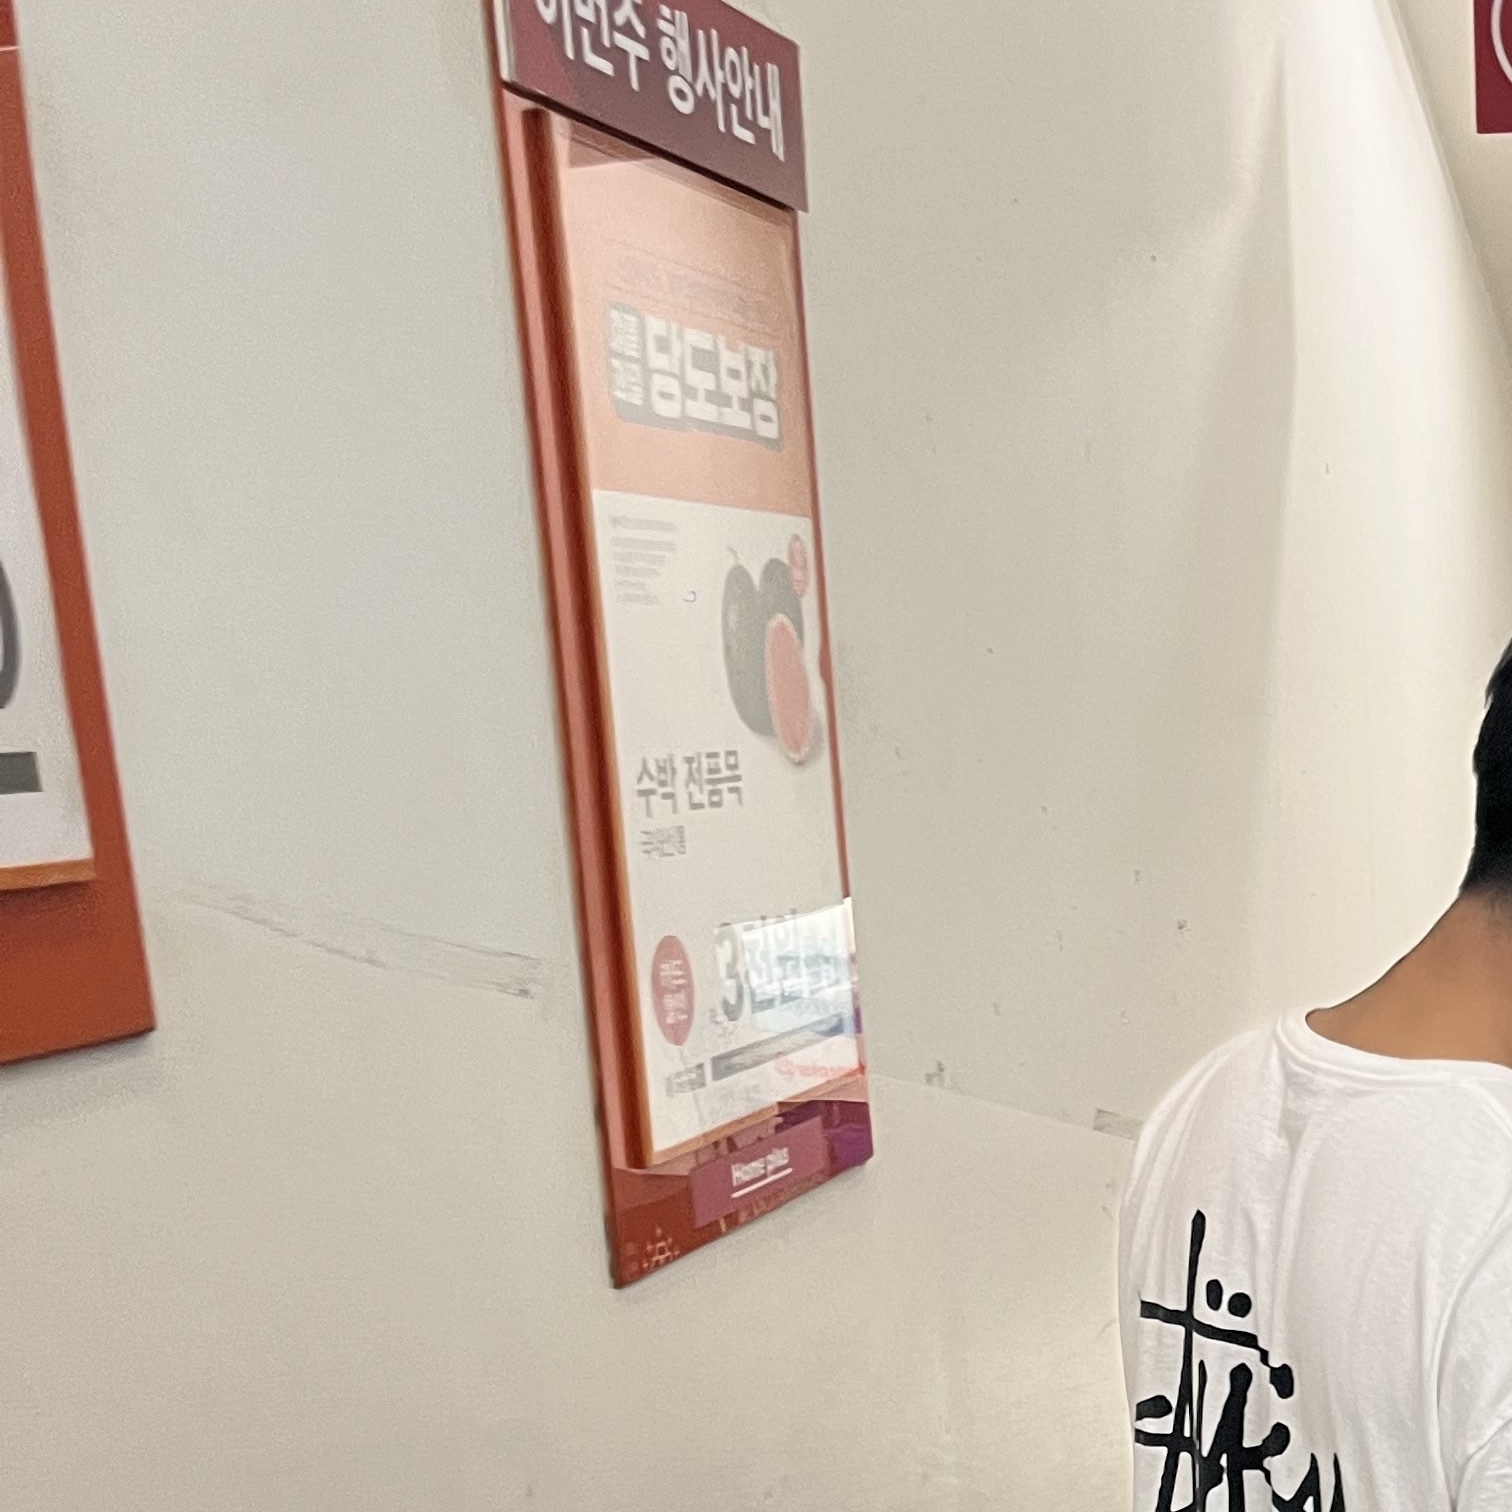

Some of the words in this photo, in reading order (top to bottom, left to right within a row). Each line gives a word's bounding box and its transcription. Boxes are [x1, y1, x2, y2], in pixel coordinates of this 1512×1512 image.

[656, 4, 785, 162] 행사안내
[647, 313, 780, 439] 당도보장
[637, 753, 679, 819] 수박
[682, 750, 744, 811] 전품목
